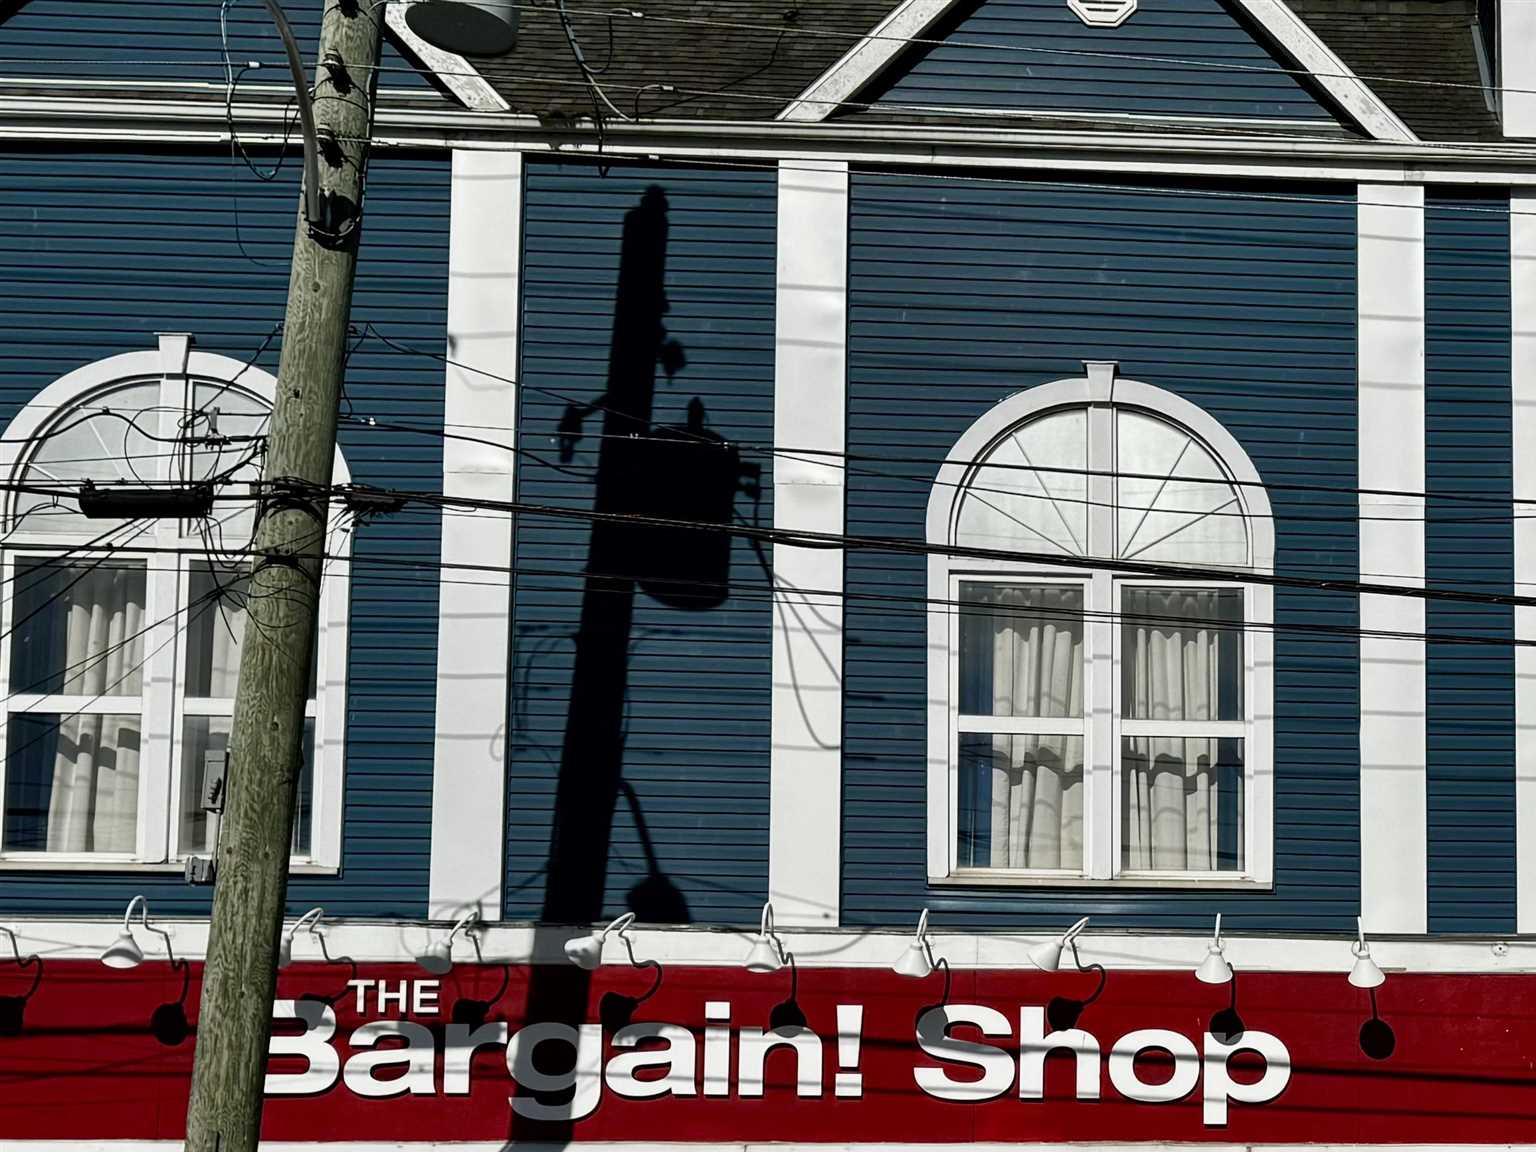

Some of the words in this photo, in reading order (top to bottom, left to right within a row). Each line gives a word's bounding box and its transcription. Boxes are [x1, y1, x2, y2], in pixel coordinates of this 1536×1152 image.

[348, 978, 440, 1013] THE
[263, 999, 863, 1121] Bargain!
[913, 1004, 1292, 1125] Shop
